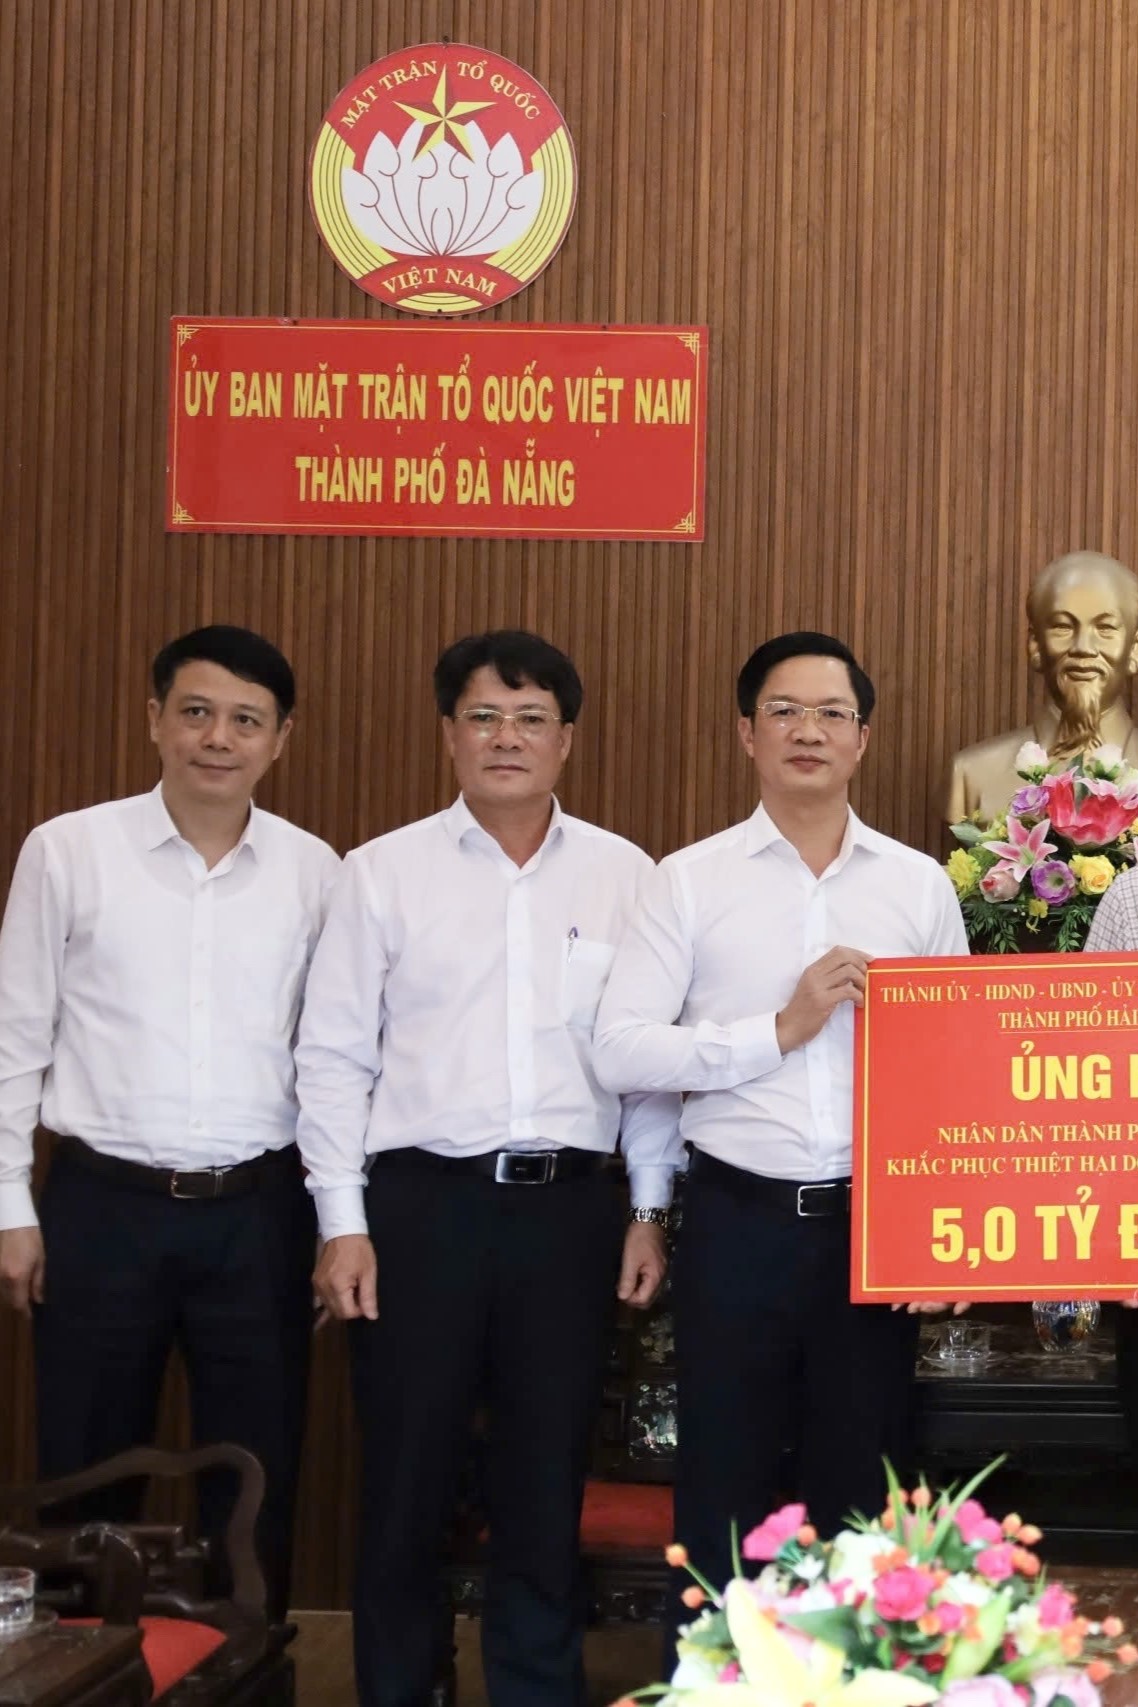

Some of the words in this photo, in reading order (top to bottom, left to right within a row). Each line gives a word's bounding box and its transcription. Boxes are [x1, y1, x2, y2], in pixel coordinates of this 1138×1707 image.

[340, 85, 379, 129] MẶT
[378, 60, 438, 92] TRẬN
[457, 60, 488, 80] TỔ
[490, 74, 541, 120] QUỐC
[382, 266, 438, 294] VIỆT
[446, 268, 498, 297] NAM
[184, 354, 220, 417] ỦY
[230, 371, 283, 418] BAN
[293, 362, 349, 433] MẶT
[358, 363, 427, 434] TRẬN
[438, 354, 473, 422] TỔ
[482, 360, 554, 424] QUỐC
[565, 366, 624, 438] VIỆT
[634, 377, 691, 425] NAM
[295, 444, 383, 503] THÀNH
[394, 443, 447, 504] PHỐ
[456, 447, 491, 505] ĐÀ
[502, 438, 575, 507] NẴNG
[880, 982, 942, 1003] THÀNH
[947, 980, 971, 1001] ỦY
[1050, 982, 1098, 999] UBND
[1111, 976, 1136, 998] ỦY
[998, 1006, 1060, 1028] THÀNH
[1065, 1002, 1103, 1027] PHỐ
[1106, 1004, 1138, 1026] HẢI
[1011, 1040, 1112, 1102] ỦNG
[937, 1121, 996, 1145] NHÂN
[1002, 1120, 1044, 1143] DÂN
[1049, 1119, 1122, 1142] THÀNH
[886, 1150, 946, 1176] KHẮC
[950, 1157, 1007, 1179] PHỤC
[1011, 1152, 1075, 1177] THIỆT
[1079, 1155, 1118, 1176] HẠI
[931, 1207, 1017, 1269] 5,0
[1035, 1186, 1099, 1261] TỶ
